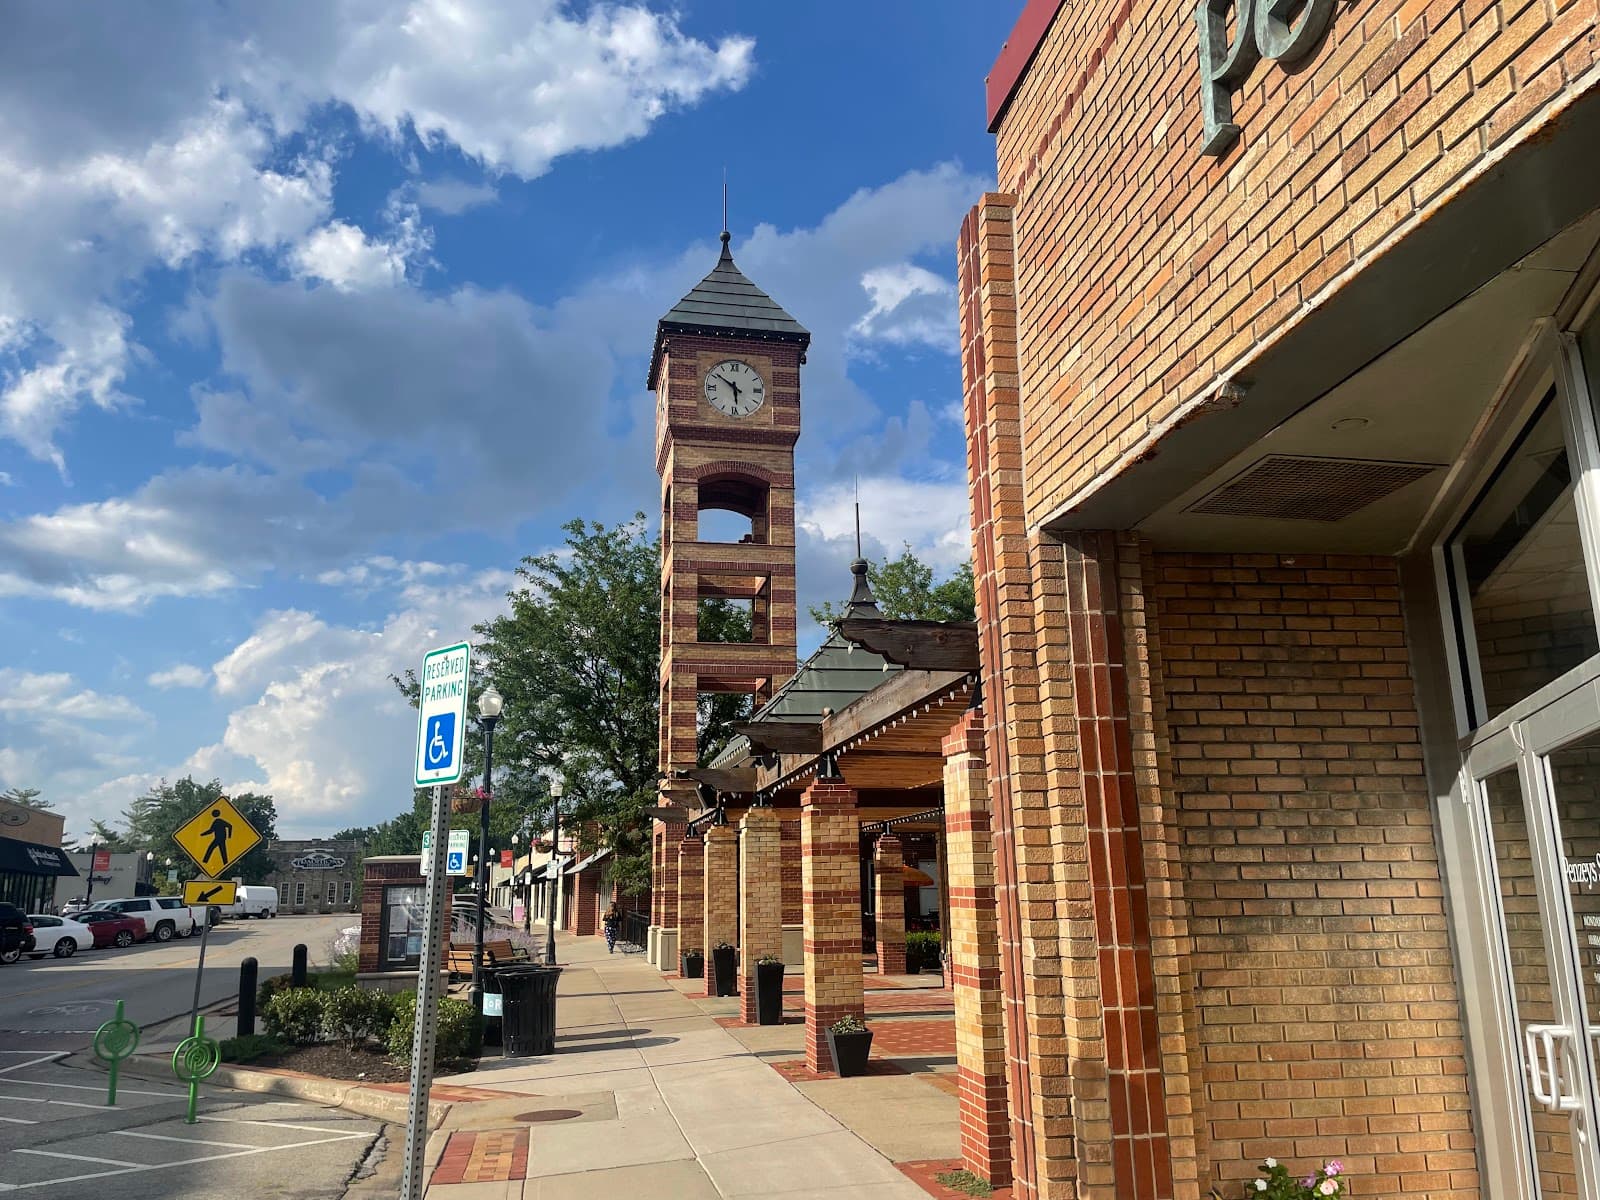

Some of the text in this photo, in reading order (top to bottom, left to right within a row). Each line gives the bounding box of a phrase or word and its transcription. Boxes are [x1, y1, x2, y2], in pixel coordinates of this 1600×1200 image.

[426, 656, 465, 681] RESERVED
[425, 679, 463, 703] PARKING
[1562, 856, 1597, 890] Penzeys
